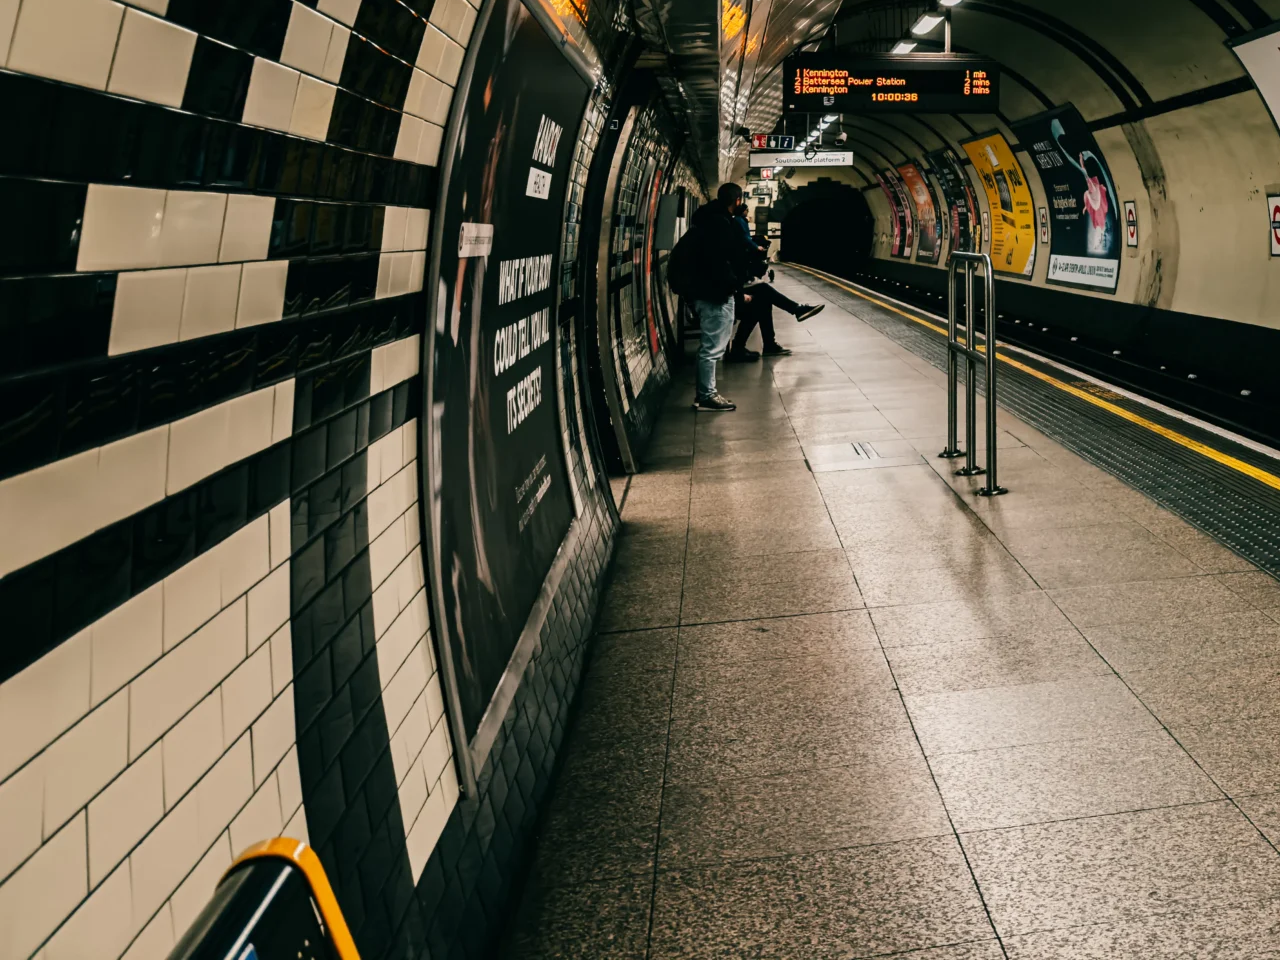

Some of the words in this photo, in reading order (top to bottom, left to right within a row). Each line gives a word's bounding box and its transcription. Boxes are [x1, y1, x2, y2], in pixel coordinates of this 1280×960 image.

[803, 68, 849, 78] Kennington
[973, 70, 986, 78] min
[794, 77, 801, 85] 2
[803, 77, 845, 85] Battersea
[848, 77, 873, 86] Power
[876, 77, 906, 86] Station
[964, 78, 970, 87] 2
[973, 78, 990, 86] mins
[794, 85, 801, 94] 3
[802, 86, 848, 95] Kennington
[964, 86, 970, 95] 6
[973, 86, 990, 94] mins
[872, 93, 918, 101] 10:00:36
[814, 156, 841, 164] platform
[498, 258, 519, 305] WHAT
[524, 255, 539, 296] YOUR
[494, 321, 518, 376] COULD
[518, 316, 530, 360] TELL
[530, 310, 541, 351] YOU
[541, 306, 549, 344] ALL
[506, 384, 516, 435] ITS
